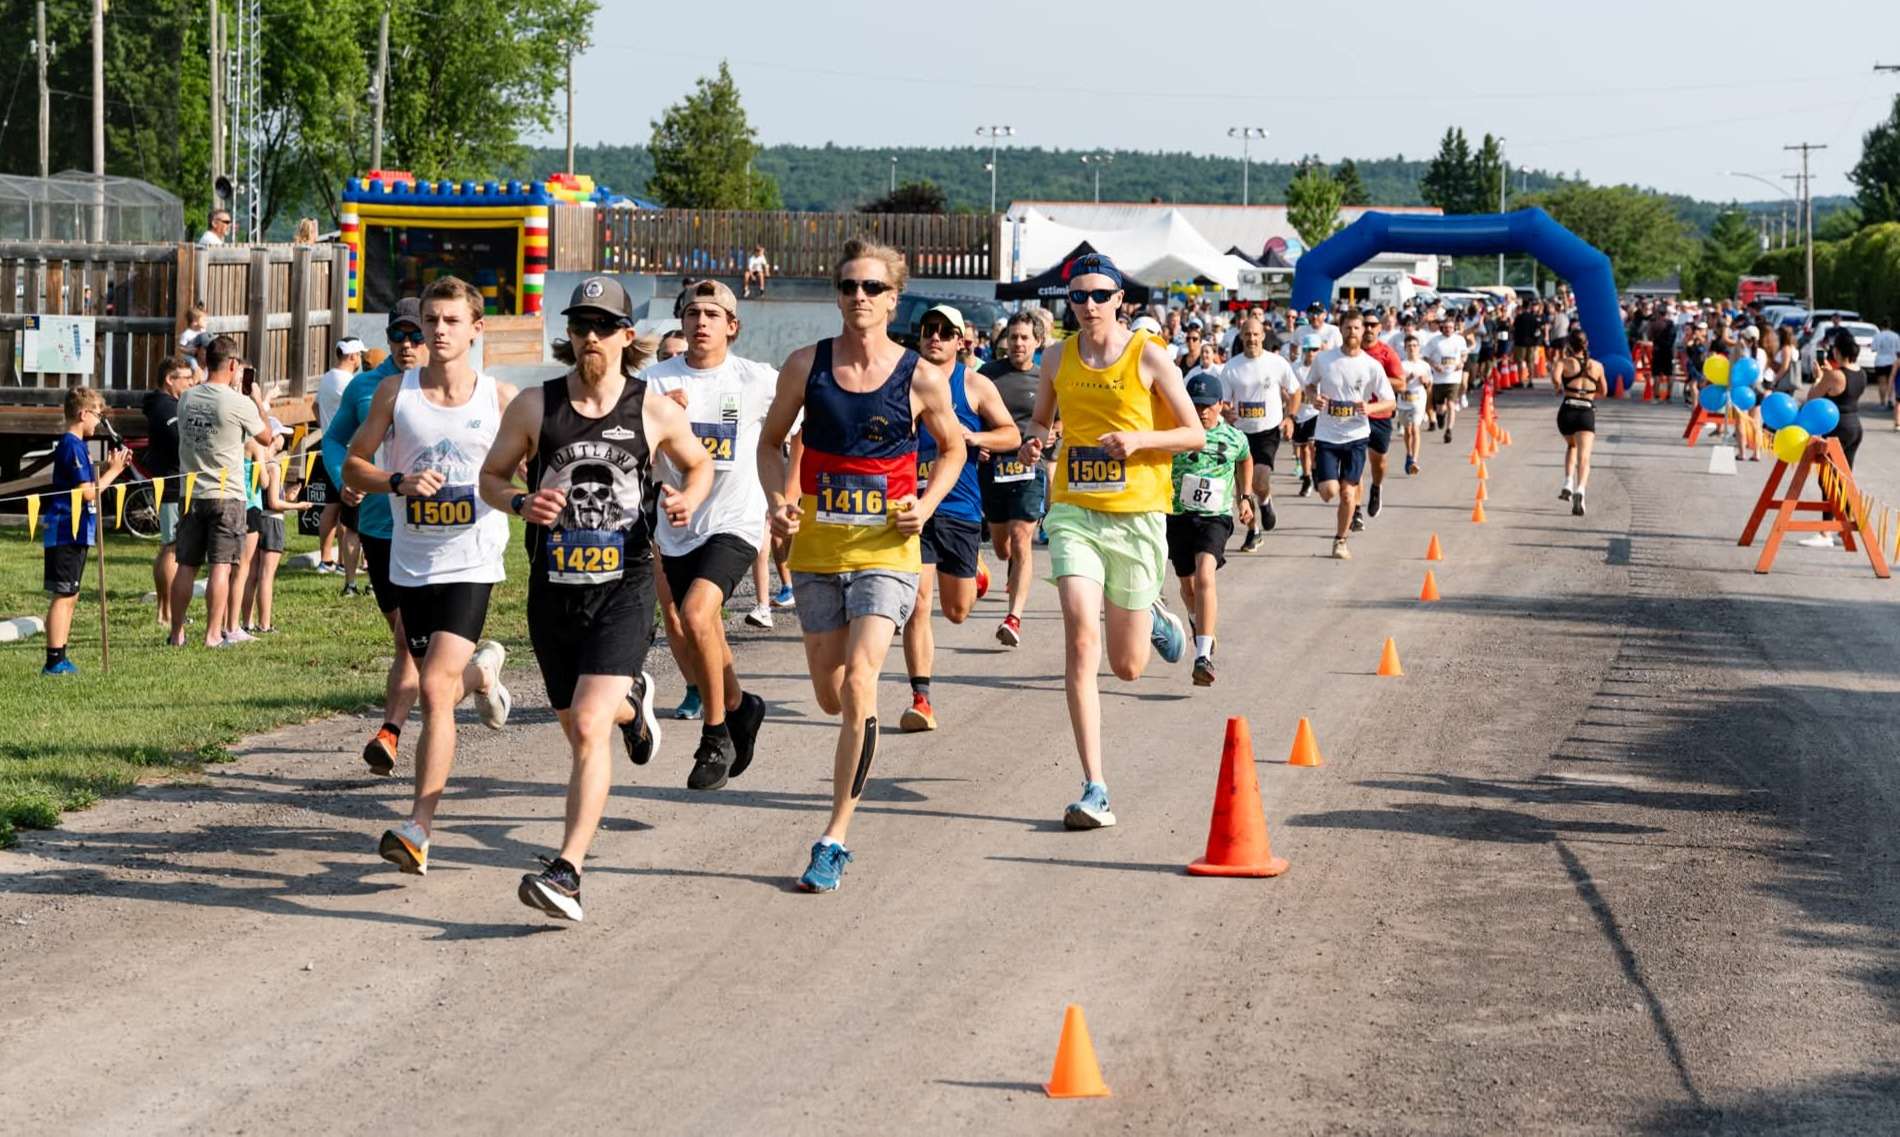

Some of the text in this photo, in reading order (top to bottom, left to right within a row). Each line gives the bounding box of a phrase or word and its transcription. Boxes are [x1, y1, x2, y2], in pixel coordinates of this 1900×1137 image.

[555, 444, 631, 466] OUTLAW
[1072, 460, 1122, 482] 1509
[822, 488, 883, 514] 1416
[1193, 488, 1212, 503] 87
[410, 500, 472, 524] 1500
[552, 545, 619, 571] 1429
